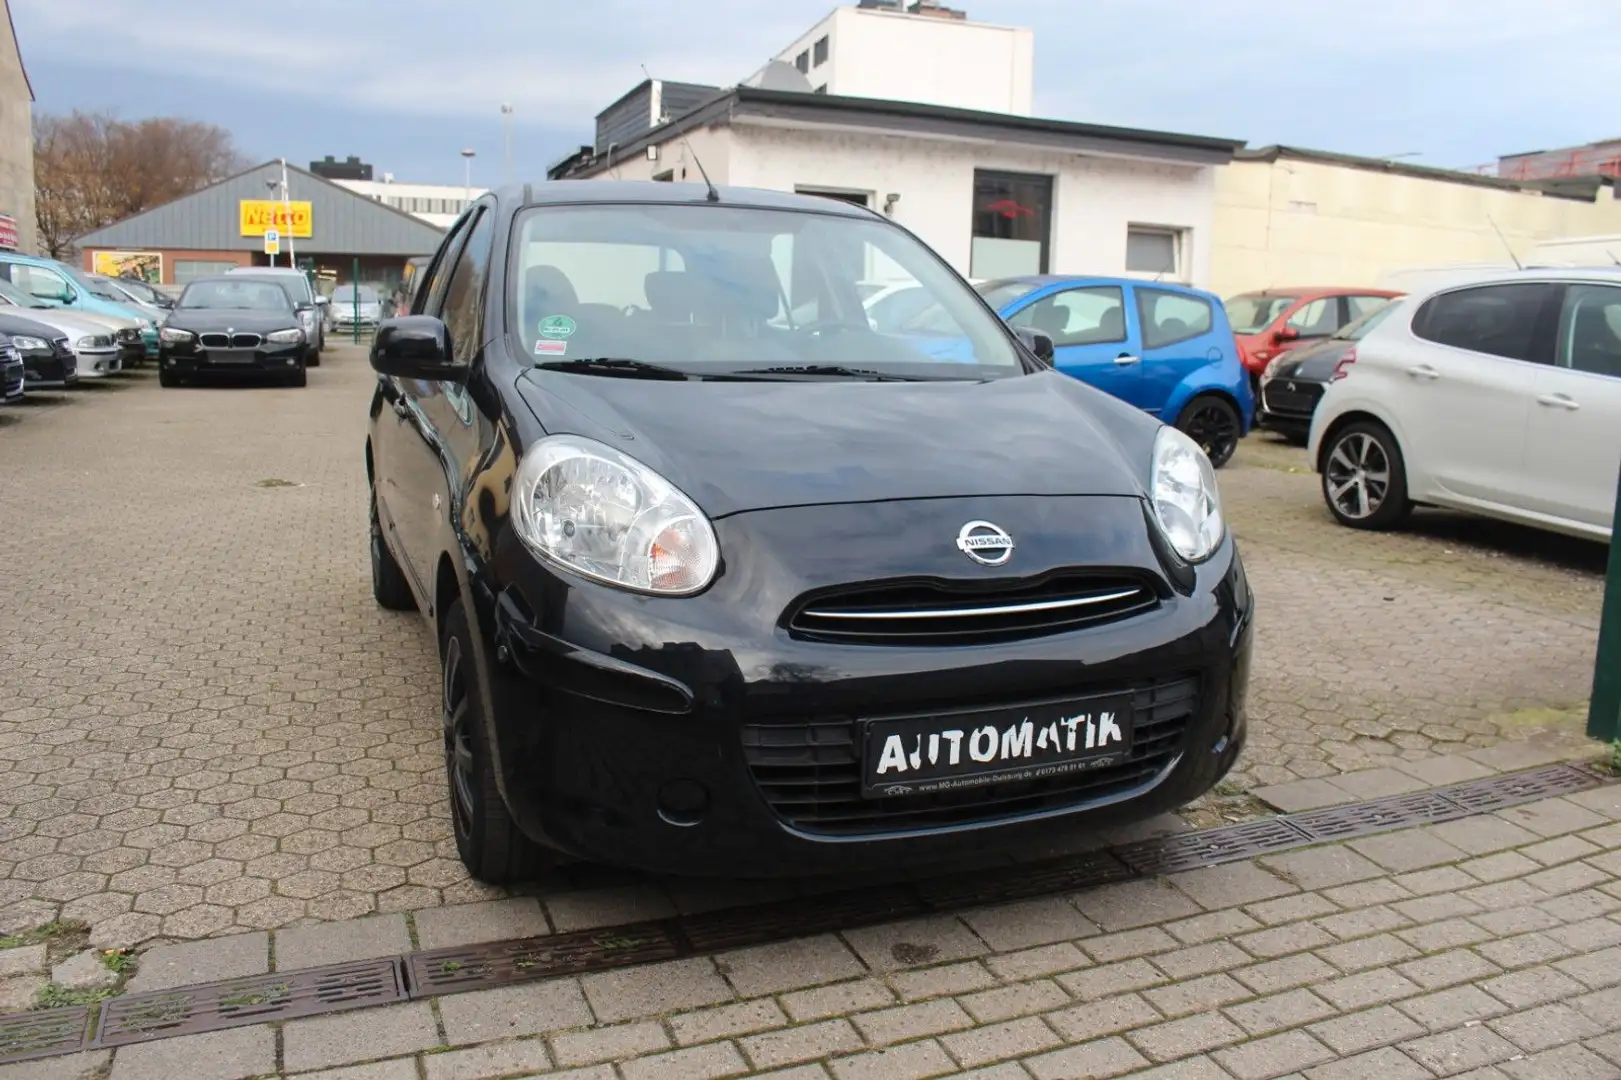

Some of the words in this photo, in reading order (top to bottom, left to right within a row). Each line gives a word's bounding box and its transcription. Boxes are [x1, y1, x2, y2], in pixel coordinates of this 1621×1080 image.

[244, 204, 308, 225] Netto
[965, 537, 1011, 546] NISSAN
[877, 712, 1122, 774] AUTOMATIK
